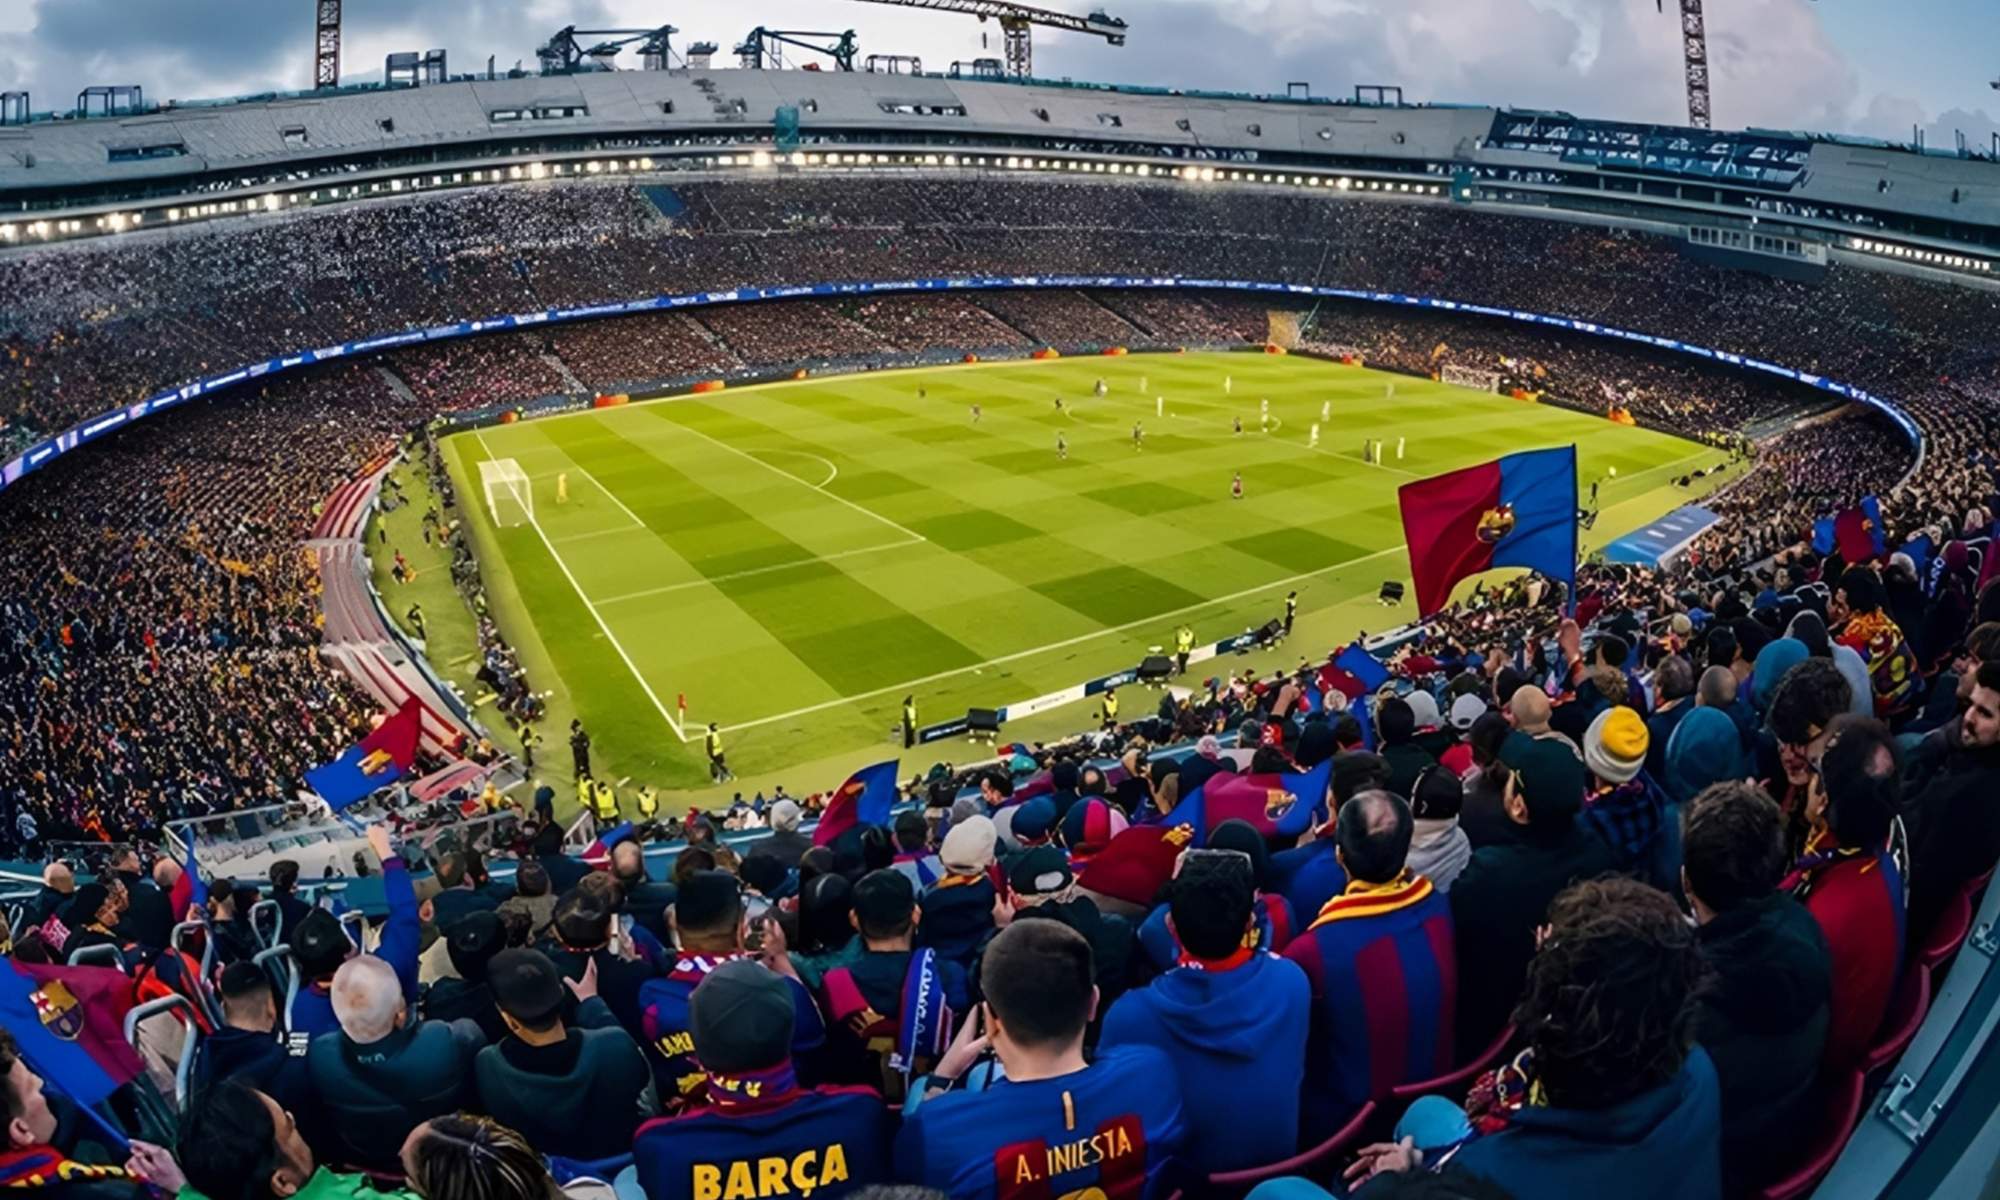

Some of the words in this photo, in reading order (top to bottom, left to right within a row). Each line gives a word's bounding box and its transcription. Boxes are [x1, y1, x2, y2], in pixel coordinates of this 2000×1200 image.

[692, 1143, 849, 1200] BARÇA
[1015, 1154, 1041, 1184] A.
[1046, 1126, 1132, 1176] INIESTA
